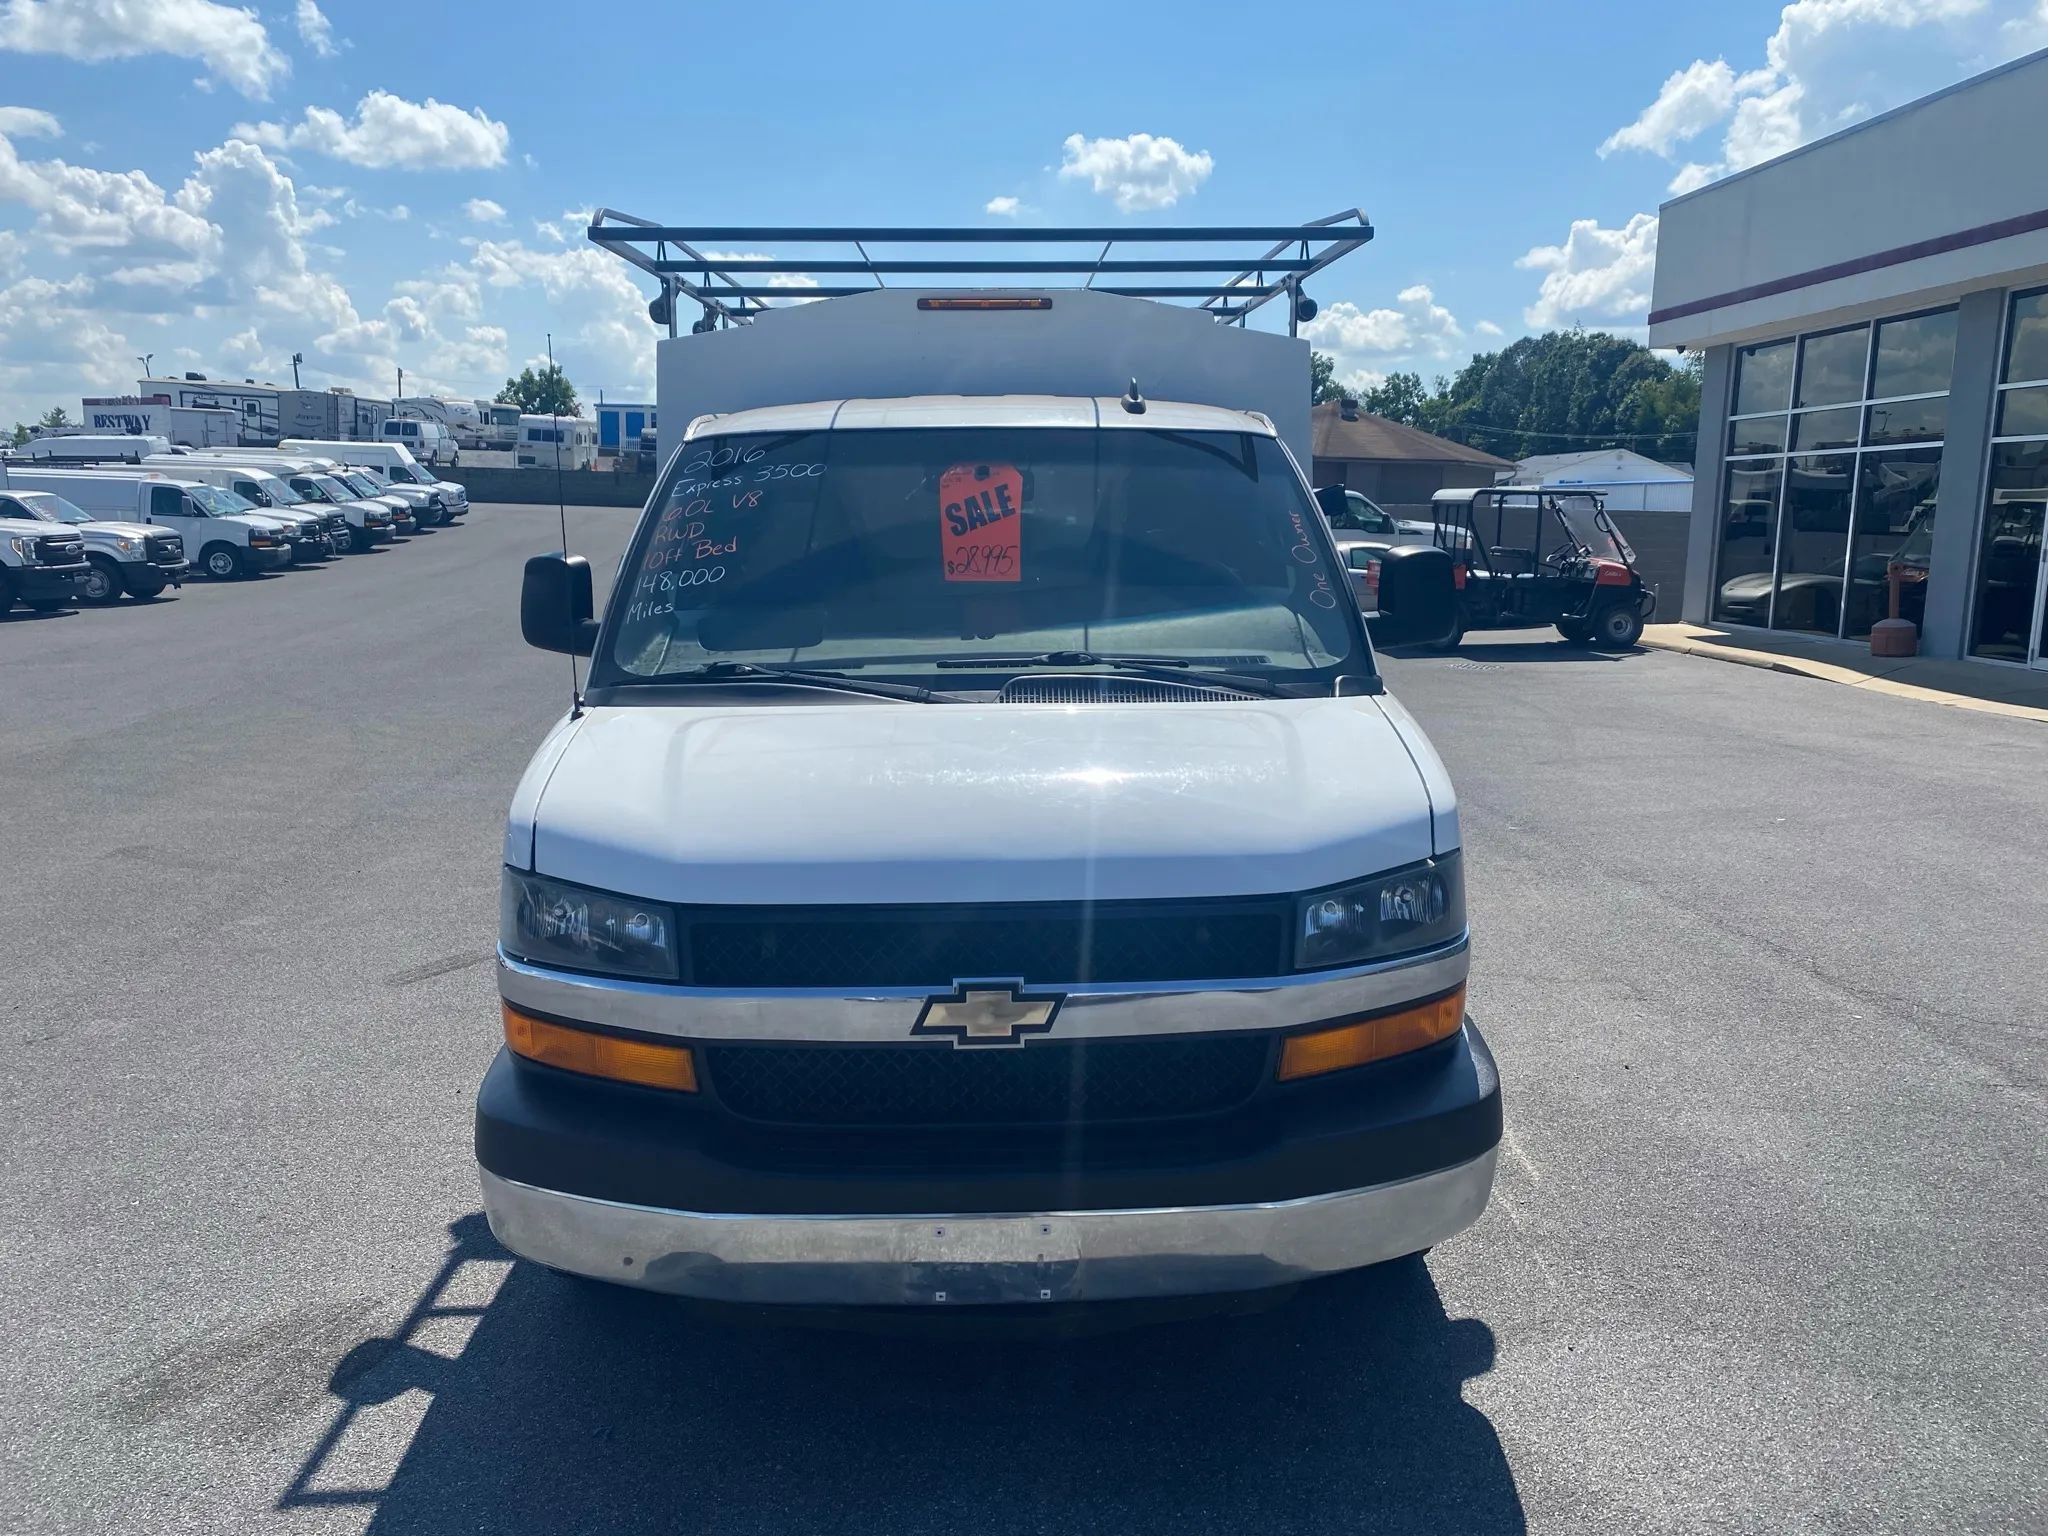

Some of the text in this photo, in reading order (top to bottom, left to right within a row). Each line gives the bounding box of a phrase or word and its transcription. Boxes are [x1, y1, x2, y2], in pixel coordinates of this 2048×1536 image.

[94, 414, 151, 431] BESTWAY
[684, 447, 766, 474] 2016
[672, 463, 827, 497] Express 3500
[732, 490, 763, 509] V8
[945, 484, 1016, 537] SALE
[654, 522, 705, 545] RWD
[692, 536, 737, 560] Bed
[1290, 510, 1336, 609] One Owner
[626, 601, 674, 624] Miles
